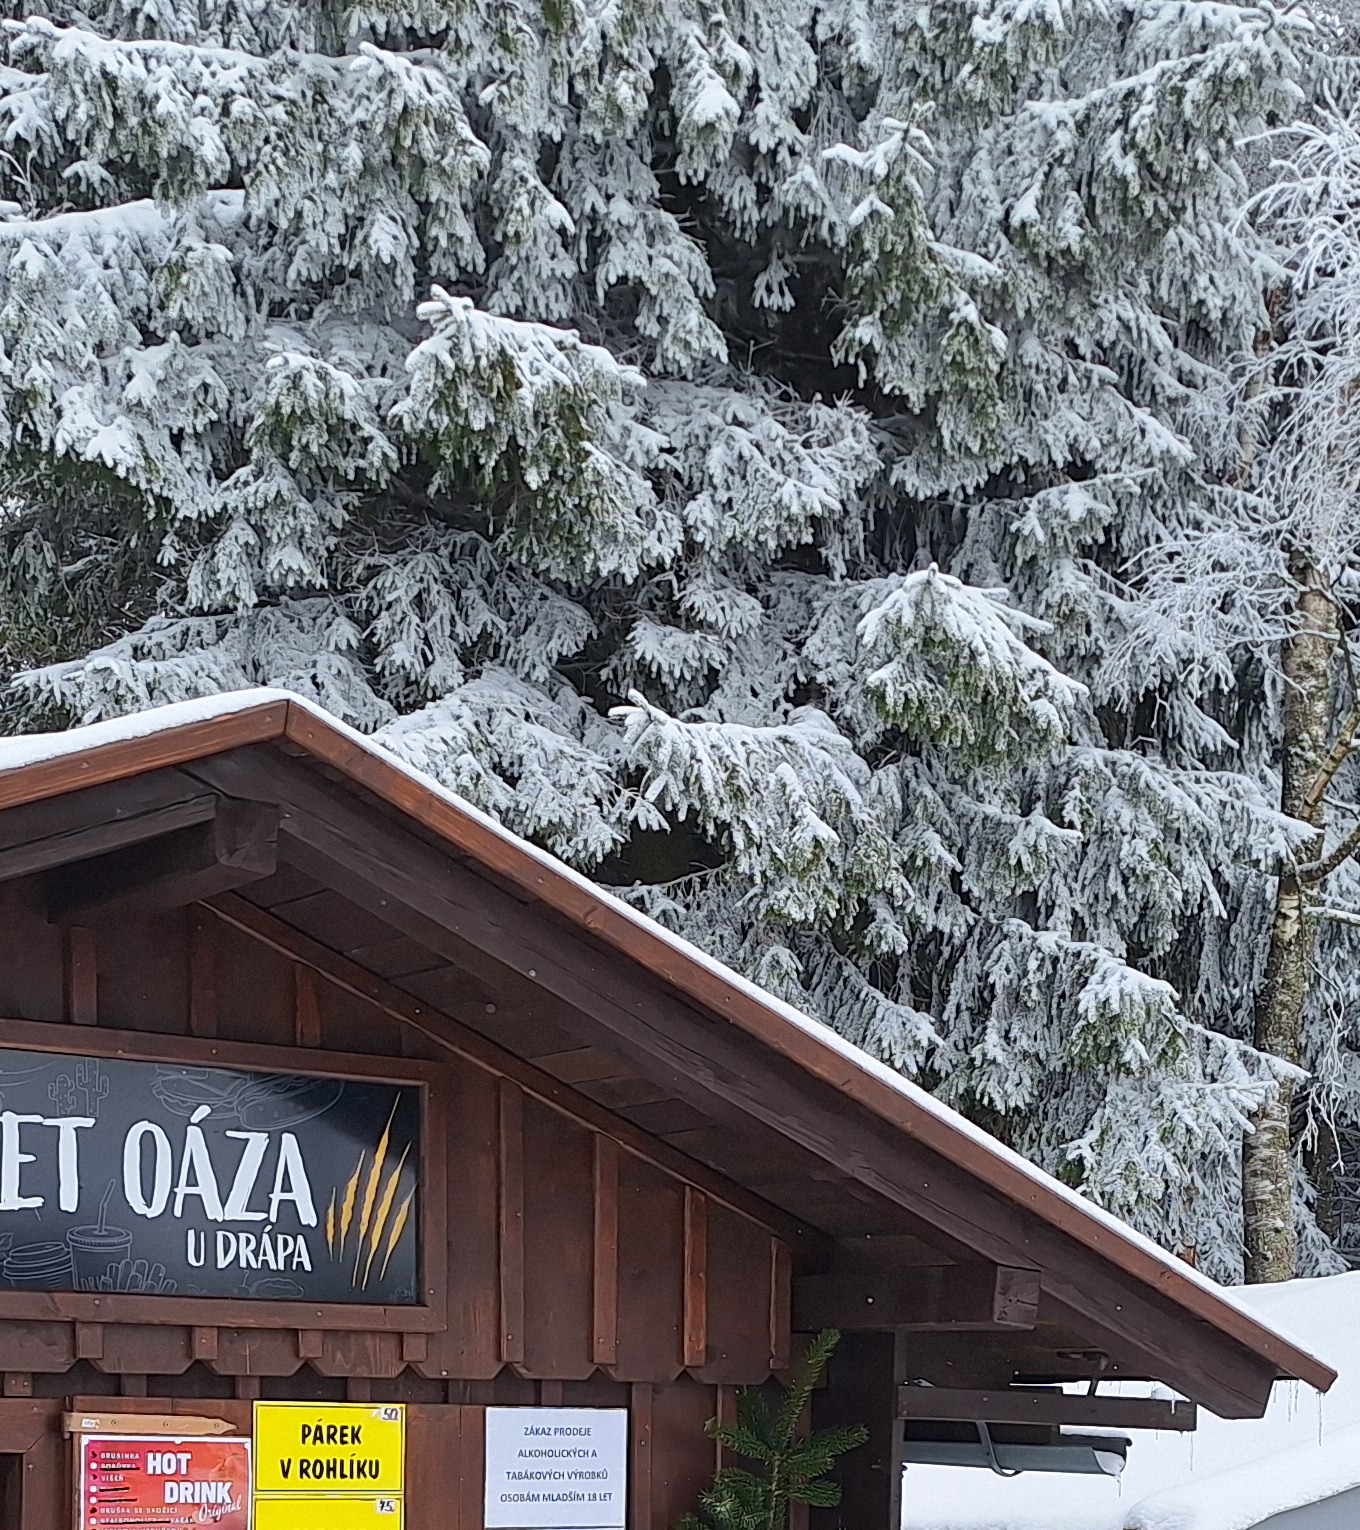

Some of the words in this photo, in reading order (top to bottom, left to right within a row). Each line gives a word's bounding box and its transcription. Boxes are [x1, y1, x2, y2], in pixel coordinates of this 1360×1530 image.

[122, 1105, 317, 1227] OÁZA
[185, 1230, 205, 1267] U
[214, 1224, 313, 1271] DRÁPA
[301, 1418, 362, 1446] PÁREK
[524, 1425, 551, 1437] ZÁKAZ
[554, 1426, 592, 1437] PRODEJE
[146, 1452, 192, 1475] HOT
[517, 1447, 589, 1459] ALKOHOLICKÝCH
[591, 1449, 598, 1459] A
[280, 1458, 292, 1480] V
[299, 1453, 380, 1480] ROHLÍKU
[506, 1469, 565, 1481] TABÁKOVÝCH
[567, 1467, 608, 1480] VÝROBKŮ
[164, 1481, 233, 1504] DRINK
[500, 1490, 541, 1503] OSOBÁM
[542, 1489, 585, 1502] MLADŠÍM
[587, 1492, 597, 1502] 18
[598, 1491, 613, 1502] LET
[198, 1494, 242, 1523] Original
